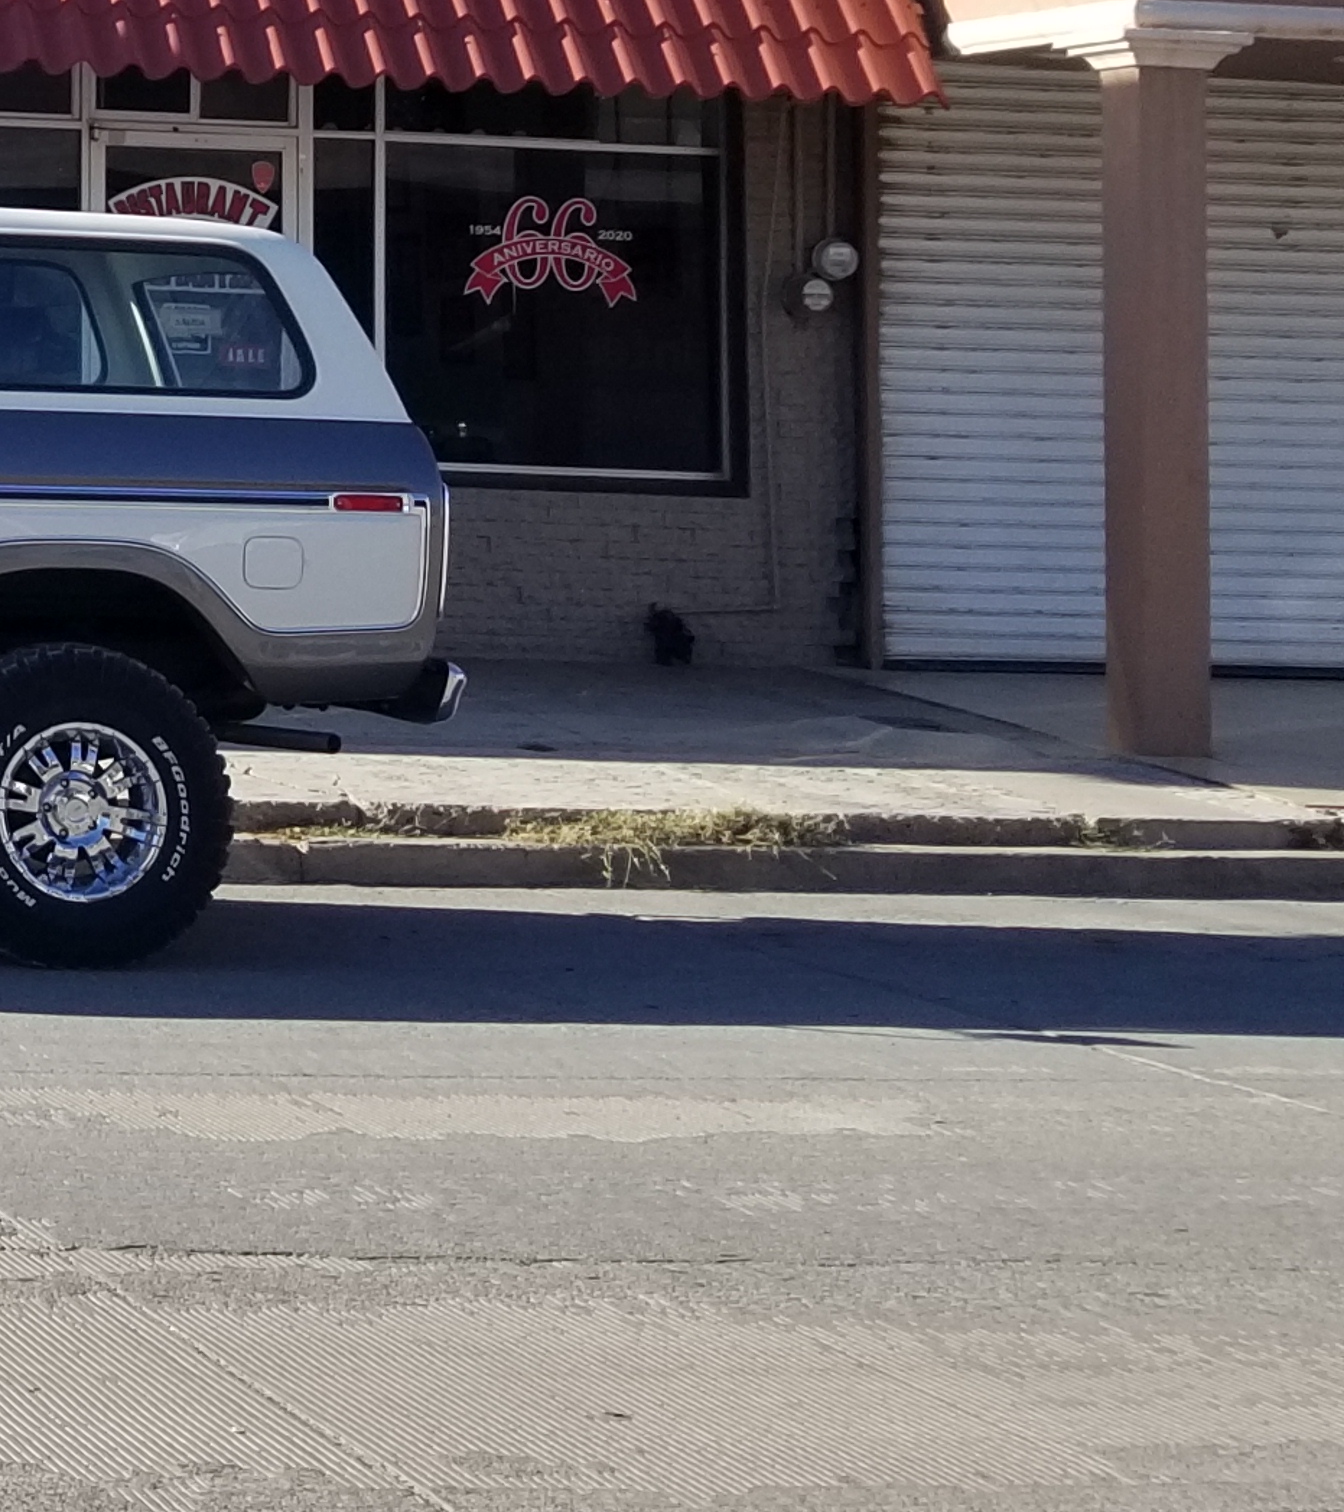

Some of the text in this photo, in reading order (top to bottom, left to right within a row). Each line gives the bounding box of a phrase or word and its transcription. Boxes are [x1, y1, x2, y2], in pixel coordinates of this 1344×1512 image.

[469, 224, 502, 236] 1954
[597, 230, 633, 241] 2020
[493, 240, 615, 272] ANIVERSARIO
[150, 736, 191, 883] BFGoodrich
